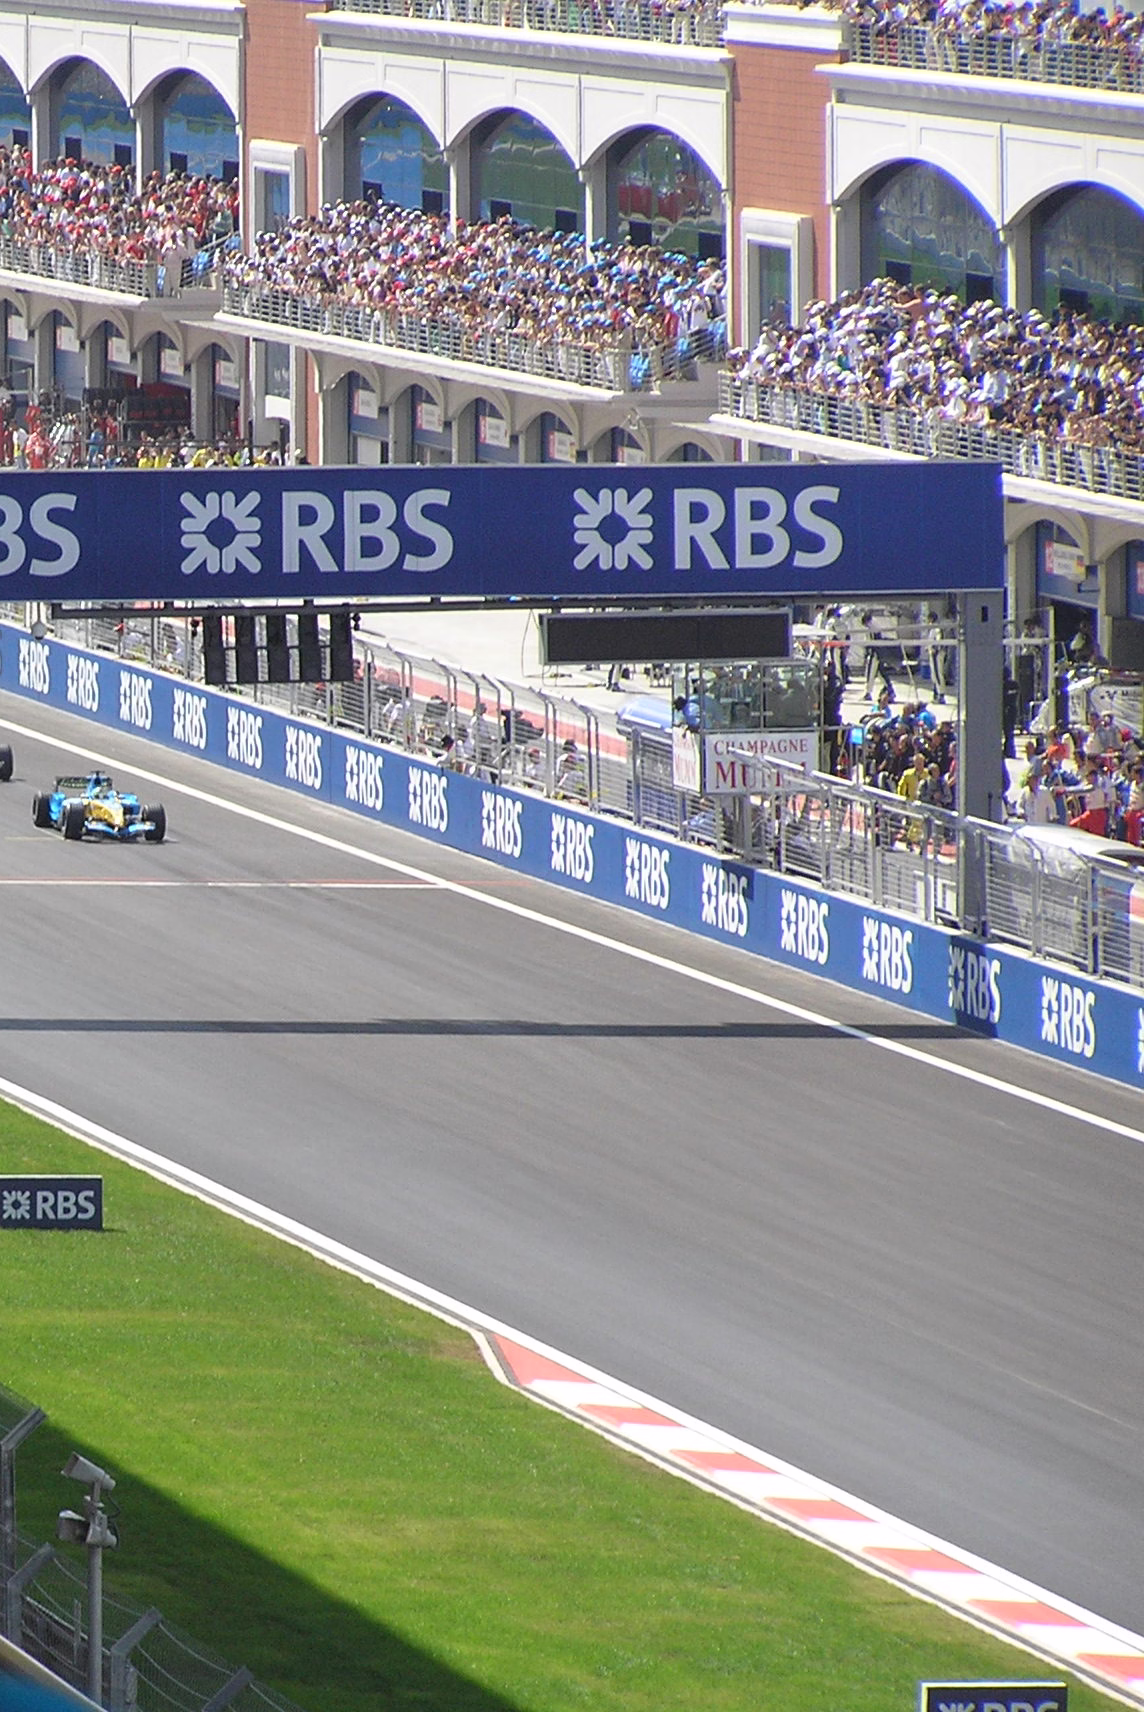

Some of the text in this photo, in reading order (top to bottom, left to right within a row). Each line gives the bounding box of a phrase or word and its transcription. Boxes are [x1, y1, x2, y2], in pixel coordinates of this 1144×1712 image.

[282, 490, 454, 574] RBS
[673, 485, 843, 571] RBS
[30, 640, 50, 695] RBS
[78, 656, 99, 713] RBS
[131, 673, 153, 731] RBS
[185, 691, 207, 750] RBS
[239, 709, 263, 770] RBS
[298, 728, 323, 791] RBS
[359, 749, 384, 811] RBS
[422, 770, 448, 833] RBS
[496, 794, 523, 859] RBS
[566, 816, 595, 884] RBS
[640, 842, 670, 911] RBS
[717, 867, 748, 937] RBS
[797, 894, 829, 966] RBS
[880, 922, 914, 994] RBS
[967, 952, 1001, 1024] RBS
[1060, 982, 1096, 1059] RBS
[36, 1190, 96, 1220] RBS
